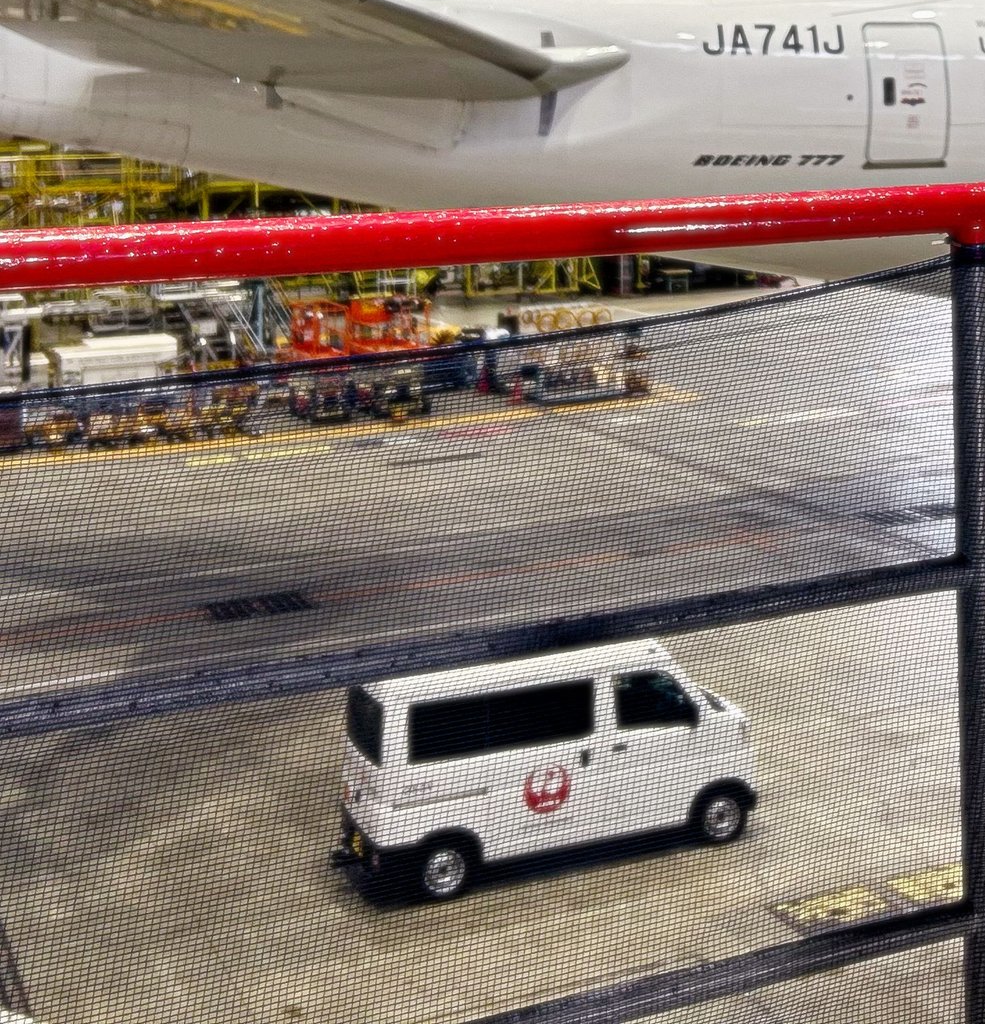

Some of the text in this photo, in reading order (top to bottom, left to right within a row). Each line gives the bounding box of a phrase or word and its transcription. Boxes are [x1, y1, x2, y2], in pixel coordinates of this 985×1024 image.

[702, 24, 845, 56] JA741J
[692, 154, 845, 167] BOEING 777
